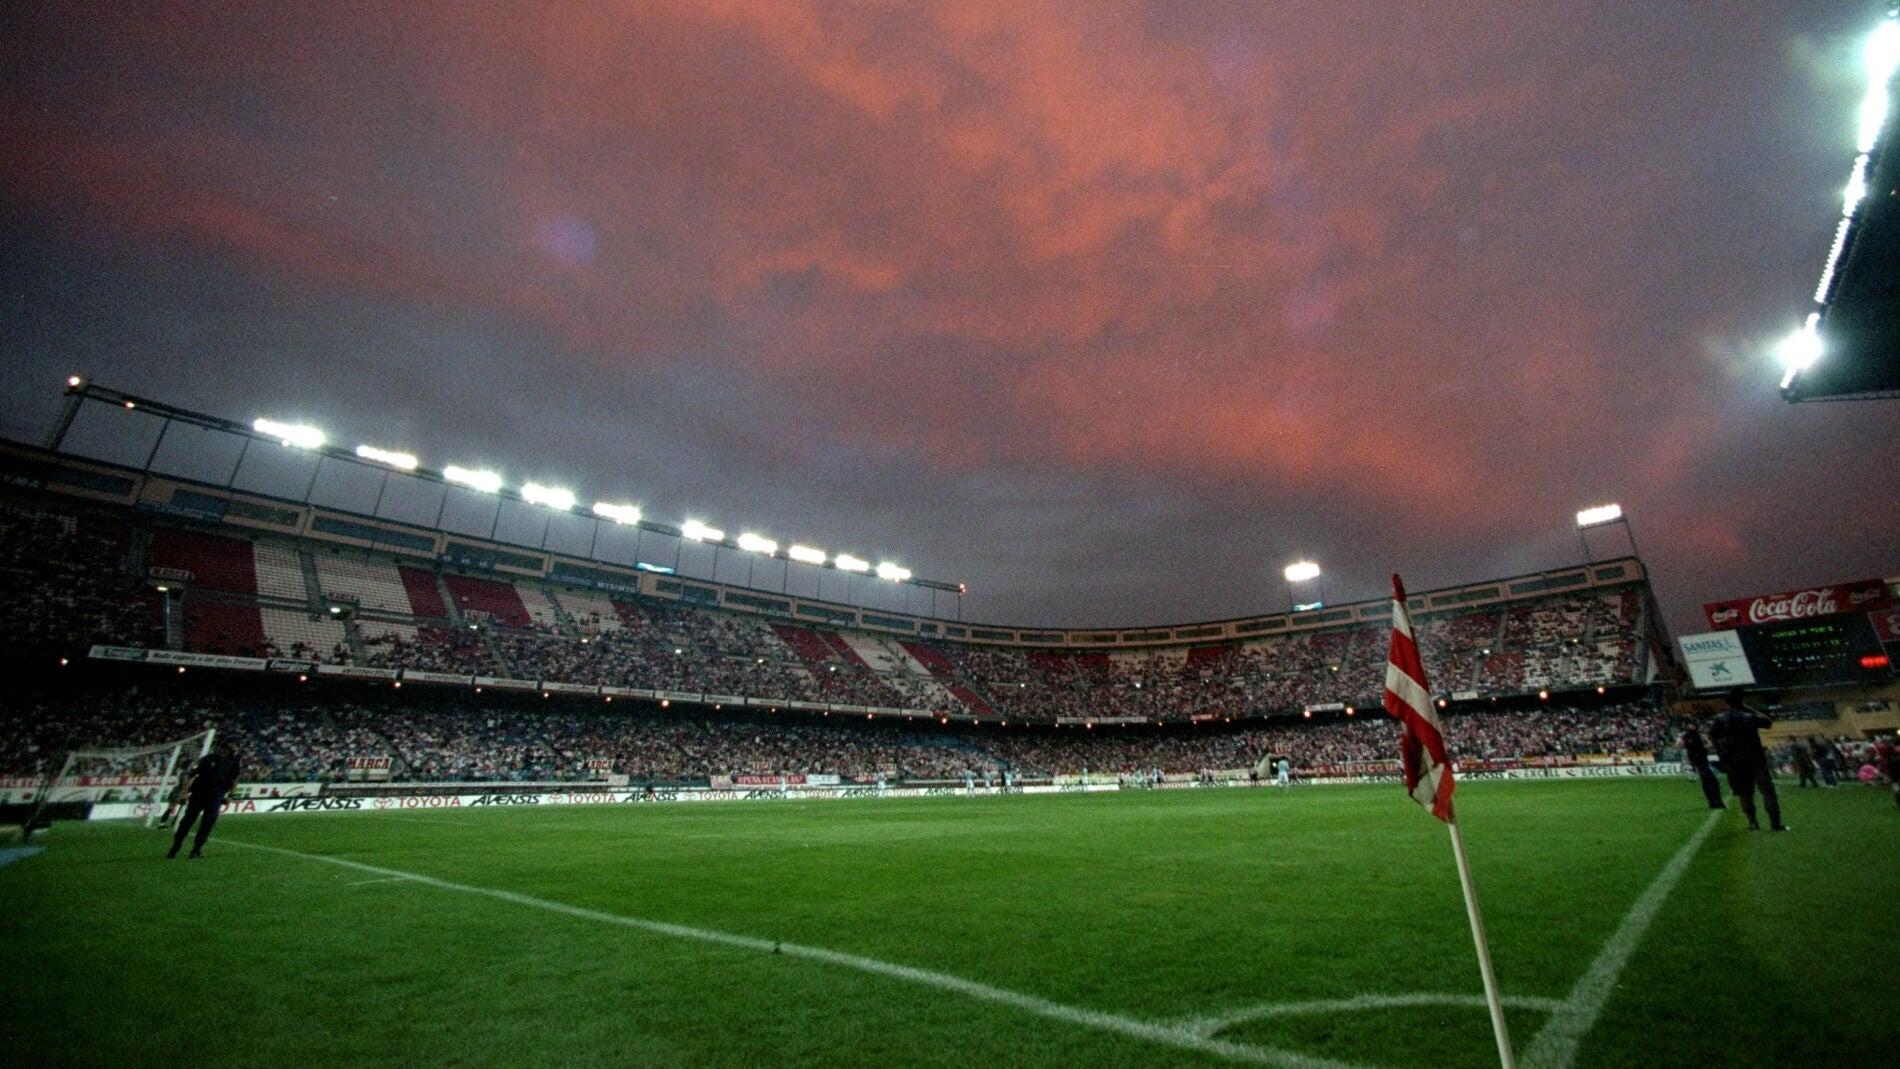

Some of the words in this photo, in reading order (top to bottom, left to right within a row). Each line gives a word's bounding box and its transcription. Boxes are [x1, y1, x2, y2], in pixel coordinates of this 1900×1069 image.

[1749, 588, 1838, 623] Coca-Cola
[1683, 639, 1725, 652] SANITAS
[348, 758, 391, 770] MARCA
[1581, 766, 1620, 777] EXCELL
[469, 794, 543, 807] AVENSIS
[567, 793, 616, 804] TOYOTA
[698, 790, 739, 801] TOYOTA
[267, 796, 366, 812] AVENSIS
[398, 796, 461, 809] TOYOTA
